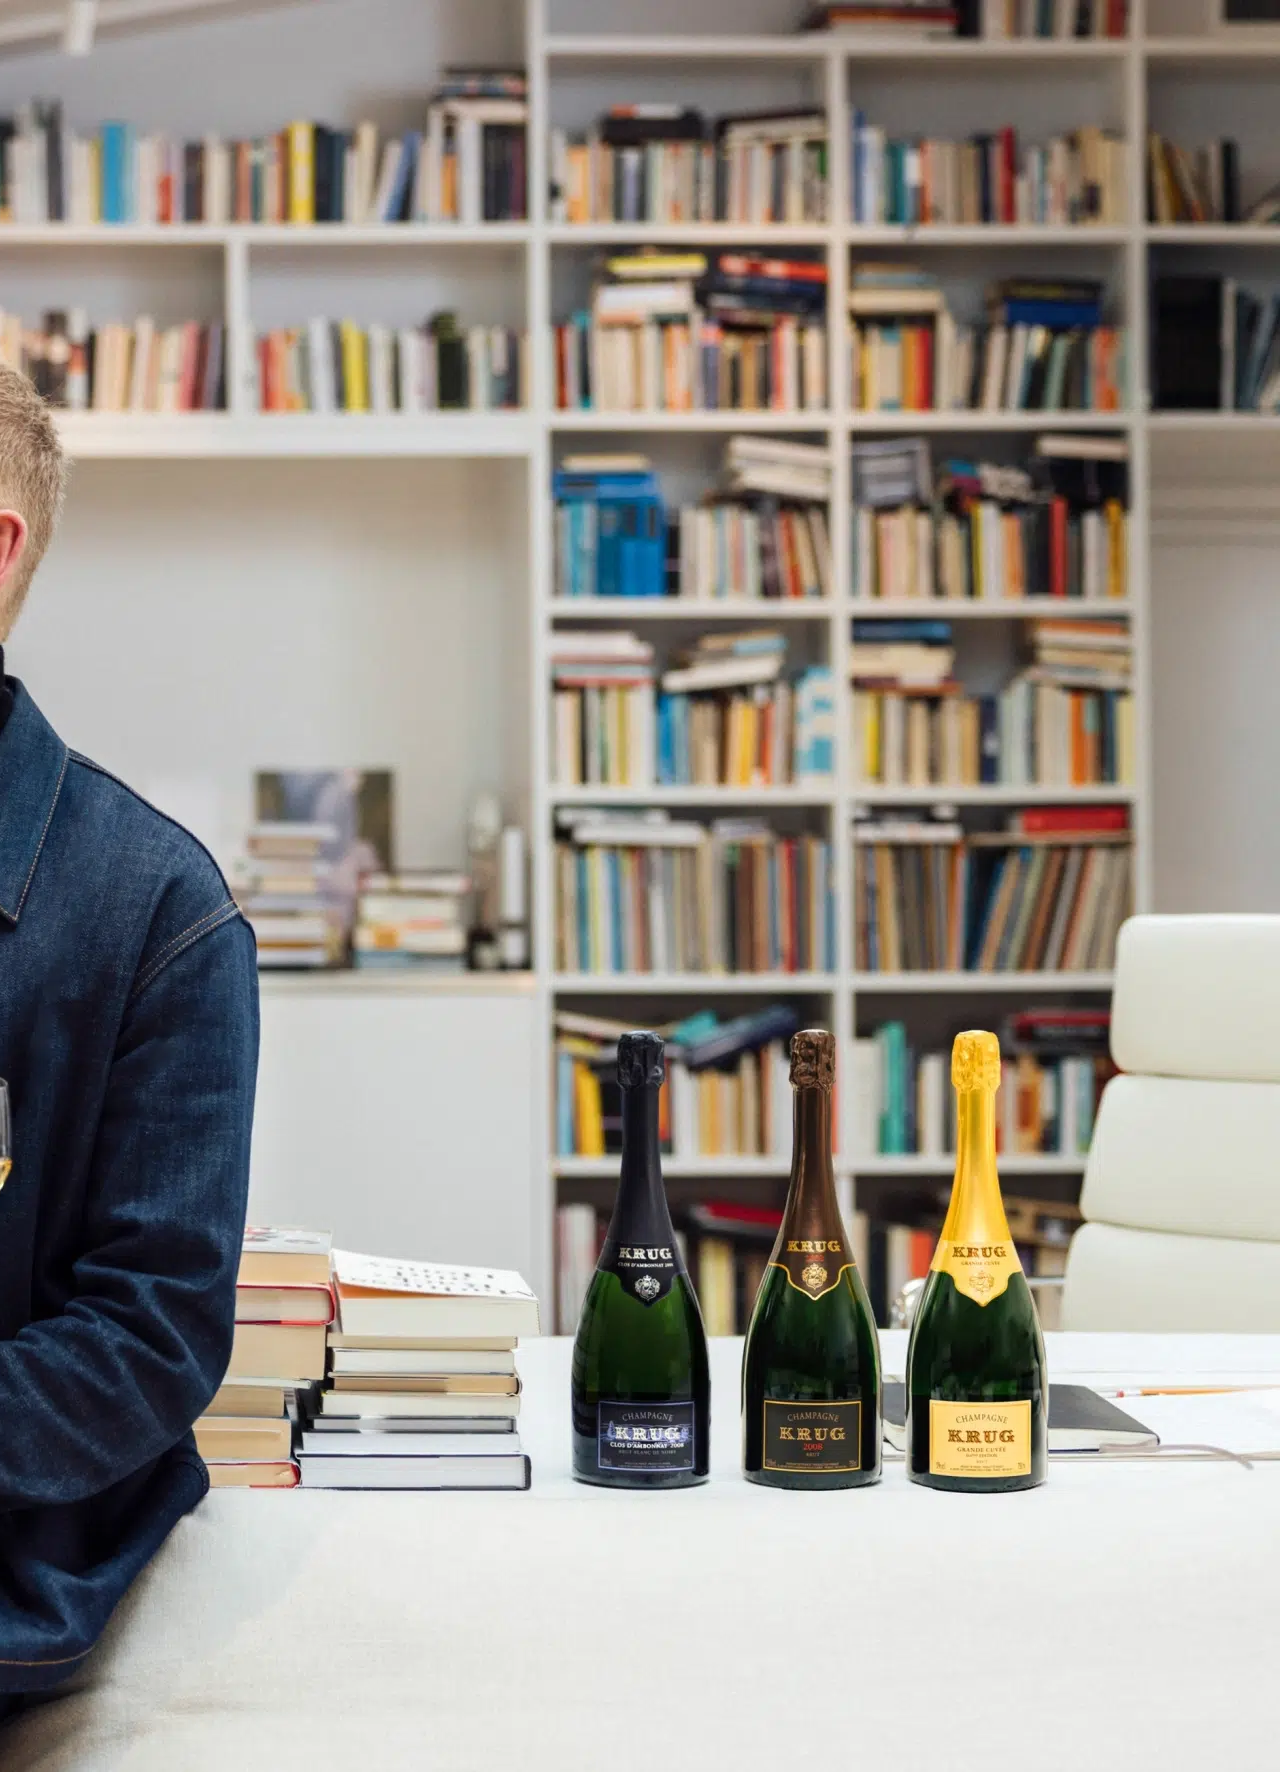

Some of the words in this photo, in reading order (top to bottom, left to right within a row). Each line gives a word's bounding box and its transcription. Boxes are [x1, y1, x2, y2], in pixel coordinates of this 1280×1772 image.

[786, 1240, 841, 1253] KRUG
[952, 1246, 1007, 1258] KRUG
[619, 1247, 672, 1260] KRUG
[622, 1411, 675, 1423] CHAMPAGNE
[787, 1411, 840, 1423] CHAMPAGNE
[955, 1413, 1009, 1424] CHAMPAGNE
[614, 1426, 681, 1441] KRUG
[779, 1426, 846, 1441] KRUG
[947, 1429, 1015, 1444] KRUG
[803, 1442, 824, 1451] 2008
